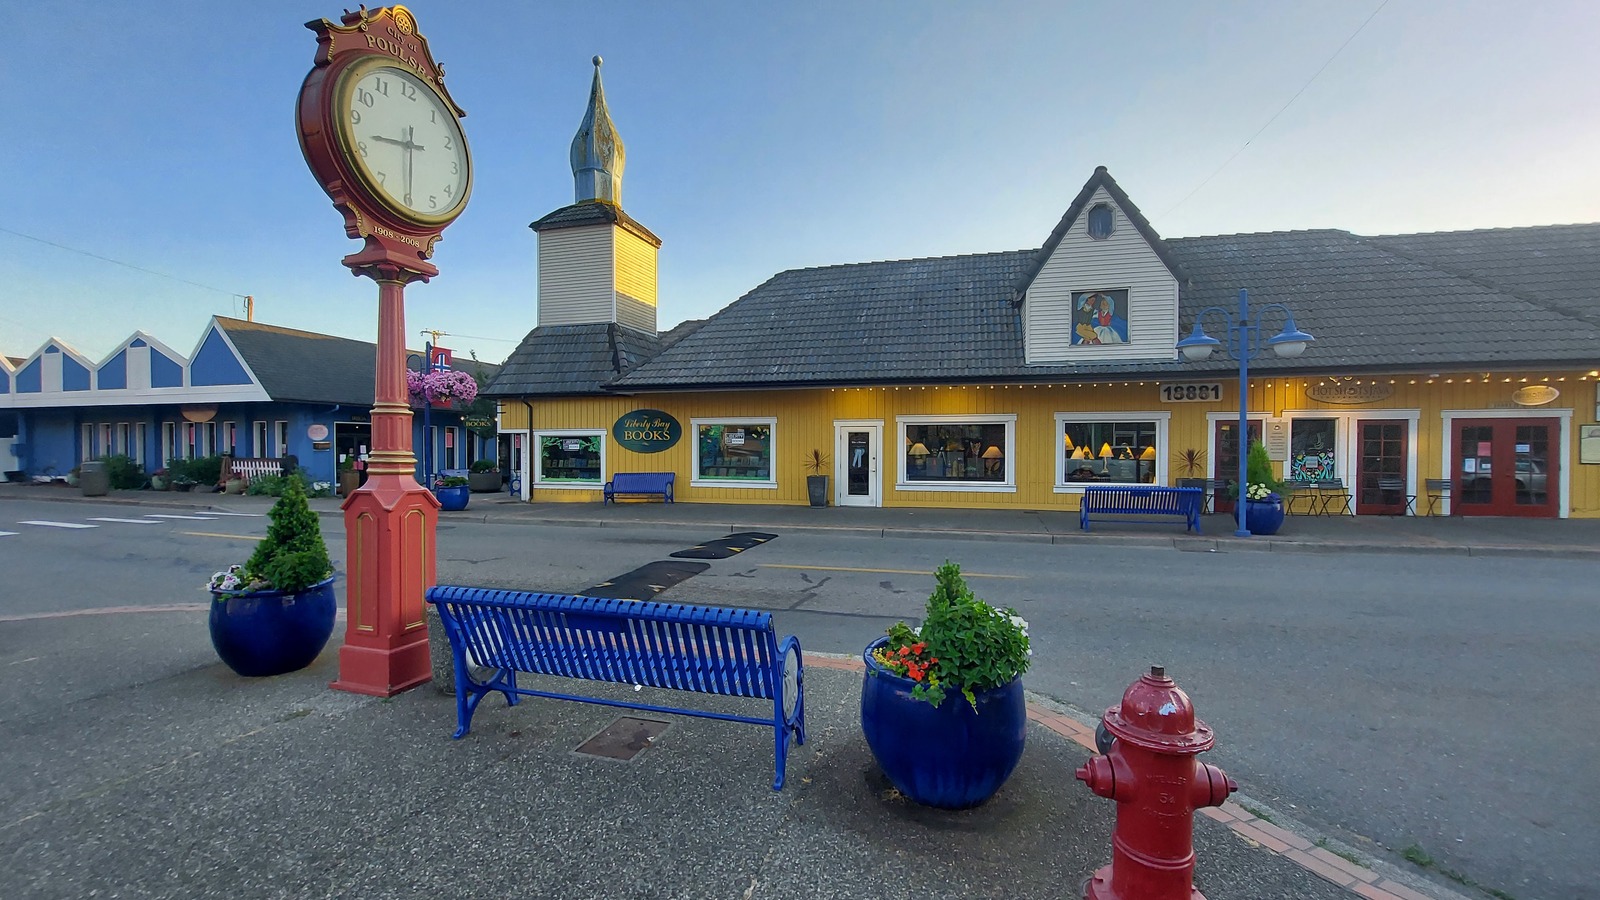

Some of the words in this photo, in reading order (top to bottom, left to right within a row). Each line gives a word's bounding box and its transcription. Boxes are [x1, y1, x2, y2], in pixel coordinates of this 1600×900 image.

[408, 42, 418, 53] of
[374, 76, 389, 98] 11
[400, 81, 417, 102] 12
[357, 87, 374, 108] 10
[351, 109, 361, 125] 9
[430, 109, 438, 125] 1
[358, 141, 368, 158] 8
[443, 135, 453, 151] 2
[450, 161, 459, 175] 3
[377, 171, 387, 187] 7
[443, 184, 453, 198] 4
[403, 193, 414, 207] 6
[428, 195, 437, 209] 5
[373, 225, 395, 239] 1908
[400, 235, 421, 248] 2008
[1163, 384, 1220, 400] 18881
[1312, 386, 1333, 396] HOT
[651, 417, 671, 431] Bay
[624, 430, 671, 441] BOOKS
